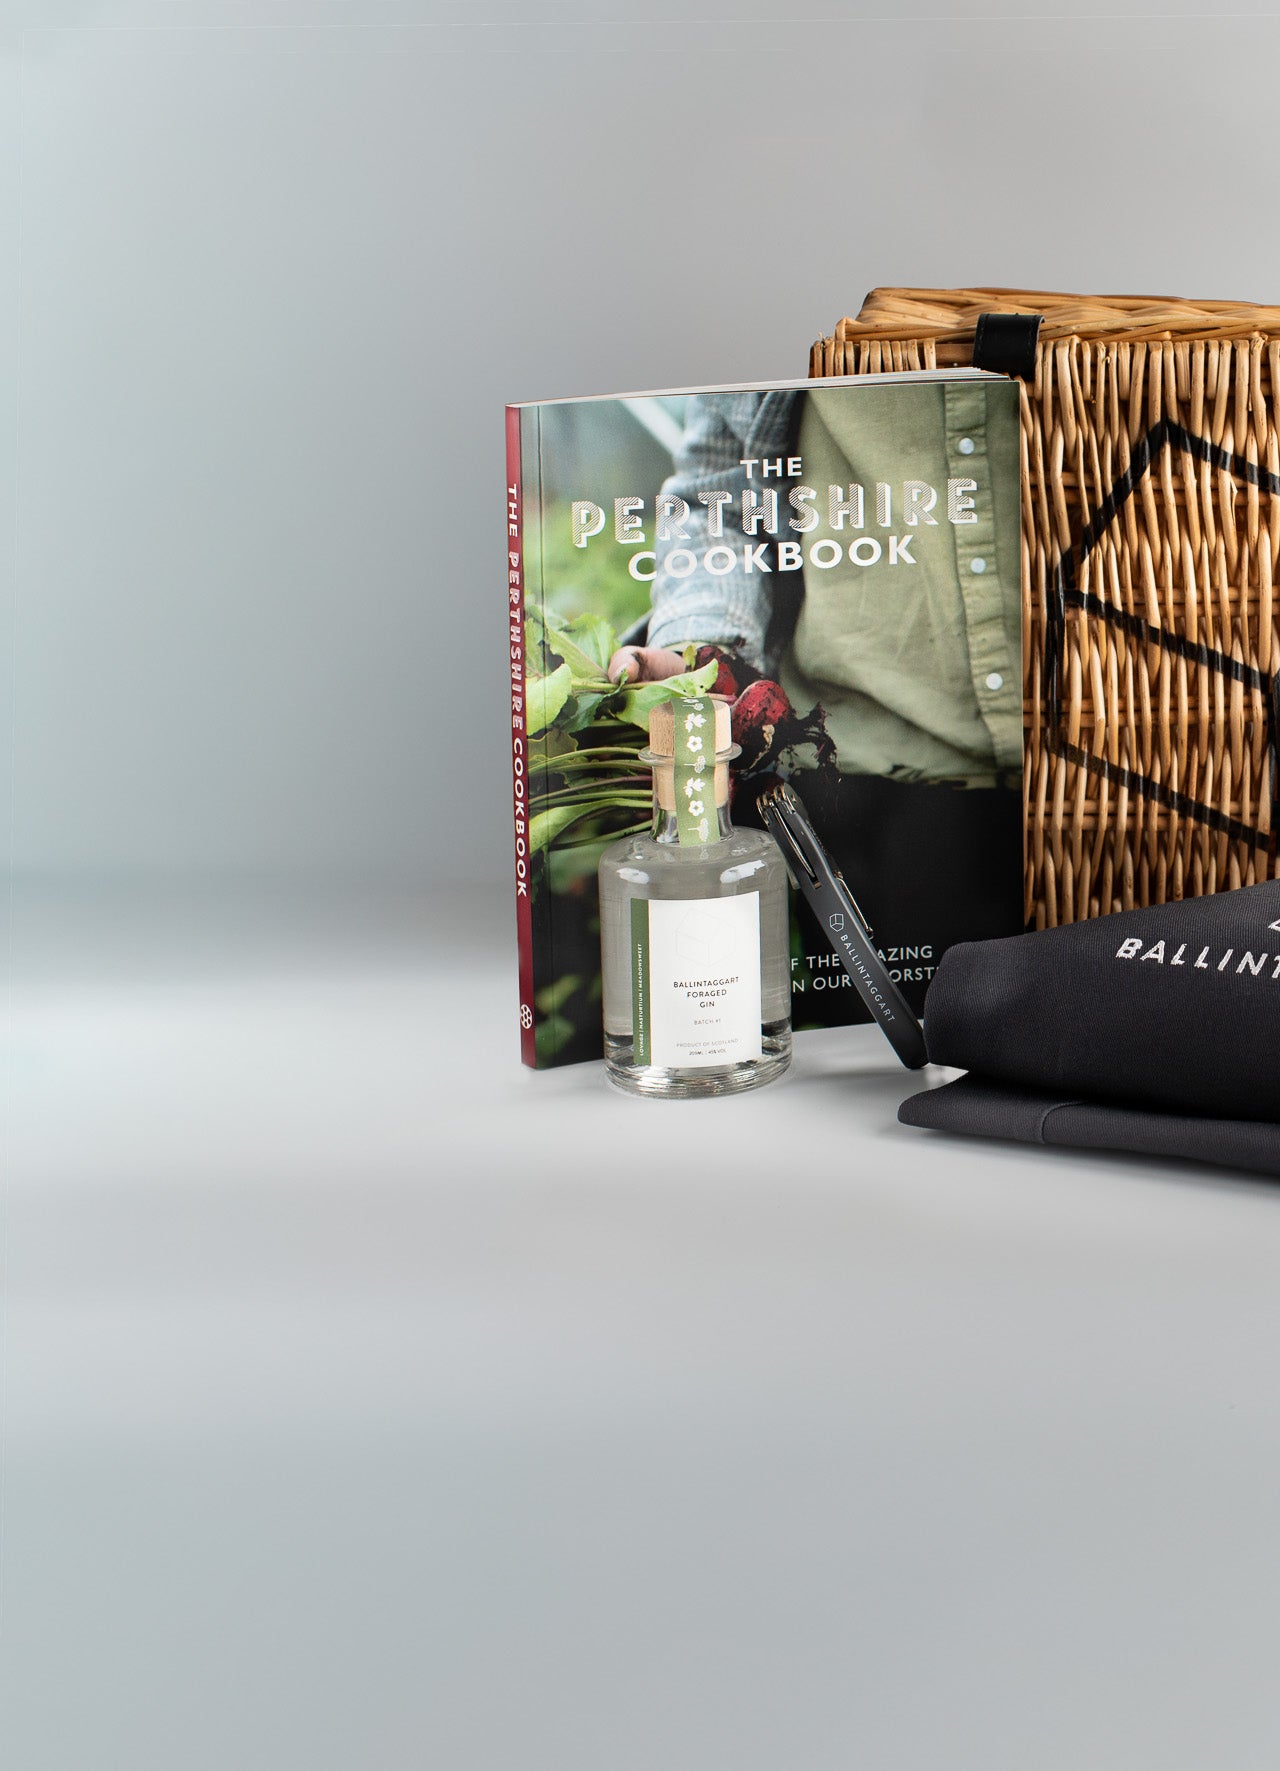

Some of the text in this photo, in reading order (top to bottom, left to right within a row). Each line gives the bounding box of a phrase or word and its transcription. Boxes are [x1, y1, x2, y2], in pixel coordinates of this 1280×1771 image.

[740, 457, 803, 478] THE
[571, 478, 979, 548] PERTHSHIRE
[628, 534, 917, 582] COOKBOOK
[508, 483, 527, 898] THE PERTHSHIRE COOKBOOK
[806, 954, 840, 970] THE
[877, 945, 933, 962] AZING
[673, 976, 740, 989] BALLINTAGGART
[813, 974, 852, 991] OUR
[840, 934, 896, 1022] BALLINTAGGART
[687, 989, 727, 998] FORAGED
